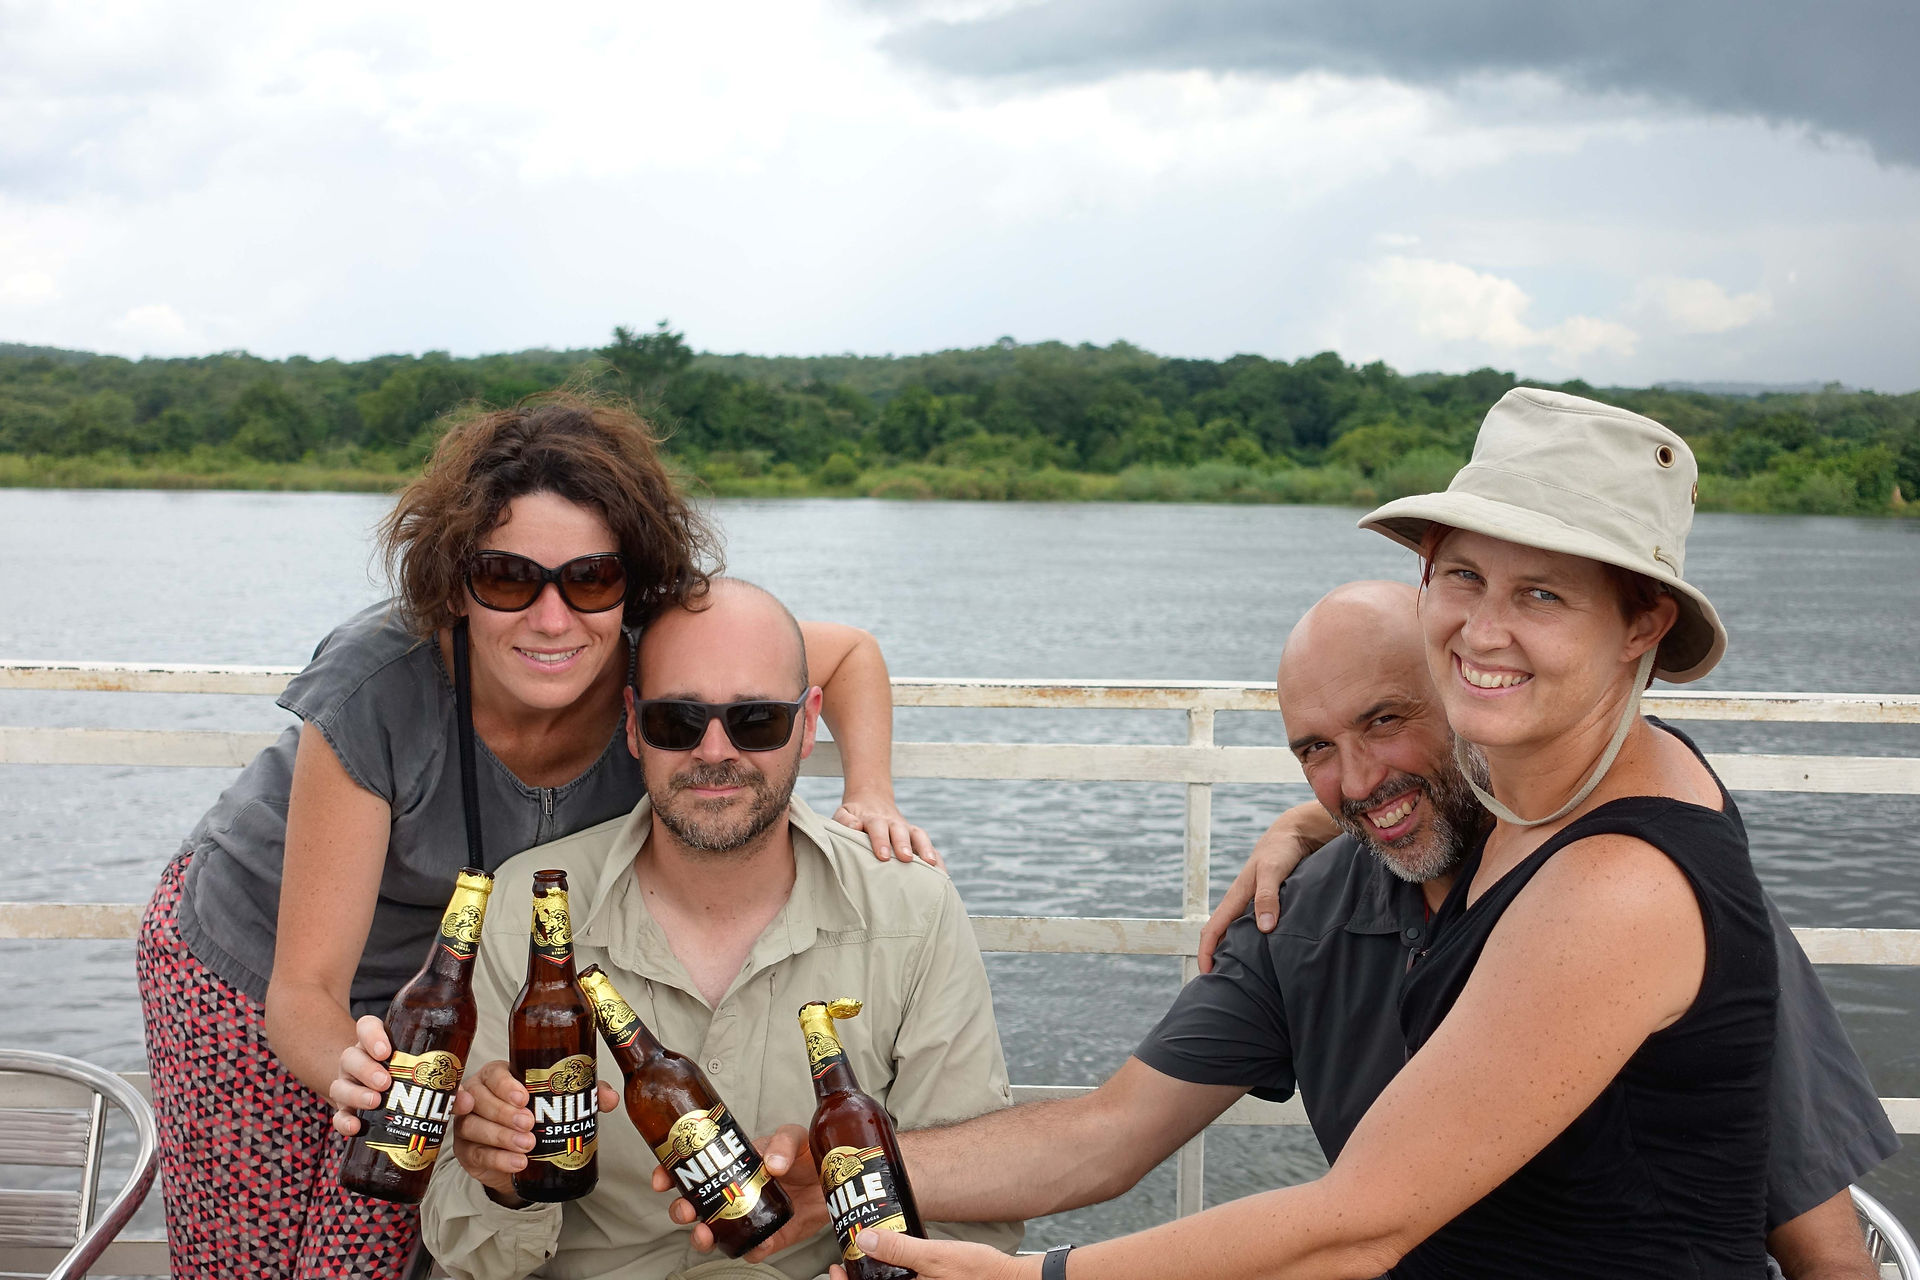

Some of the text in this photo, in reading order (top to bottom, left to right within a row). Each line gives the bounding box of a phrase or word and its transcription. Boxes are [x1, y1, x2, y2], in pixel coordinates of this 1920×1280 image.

[393, 1115, 443, 1135] SPECIAL
[545, 1118, 595, 1136] SPECIAL
[674, 1128, 747, 1192] NILE
[698, 1160, 747, 1198] SPECIAL
[826, 1172, 887, 1225] NILE
[835, 1203, 878, 1234] SPECIAL
